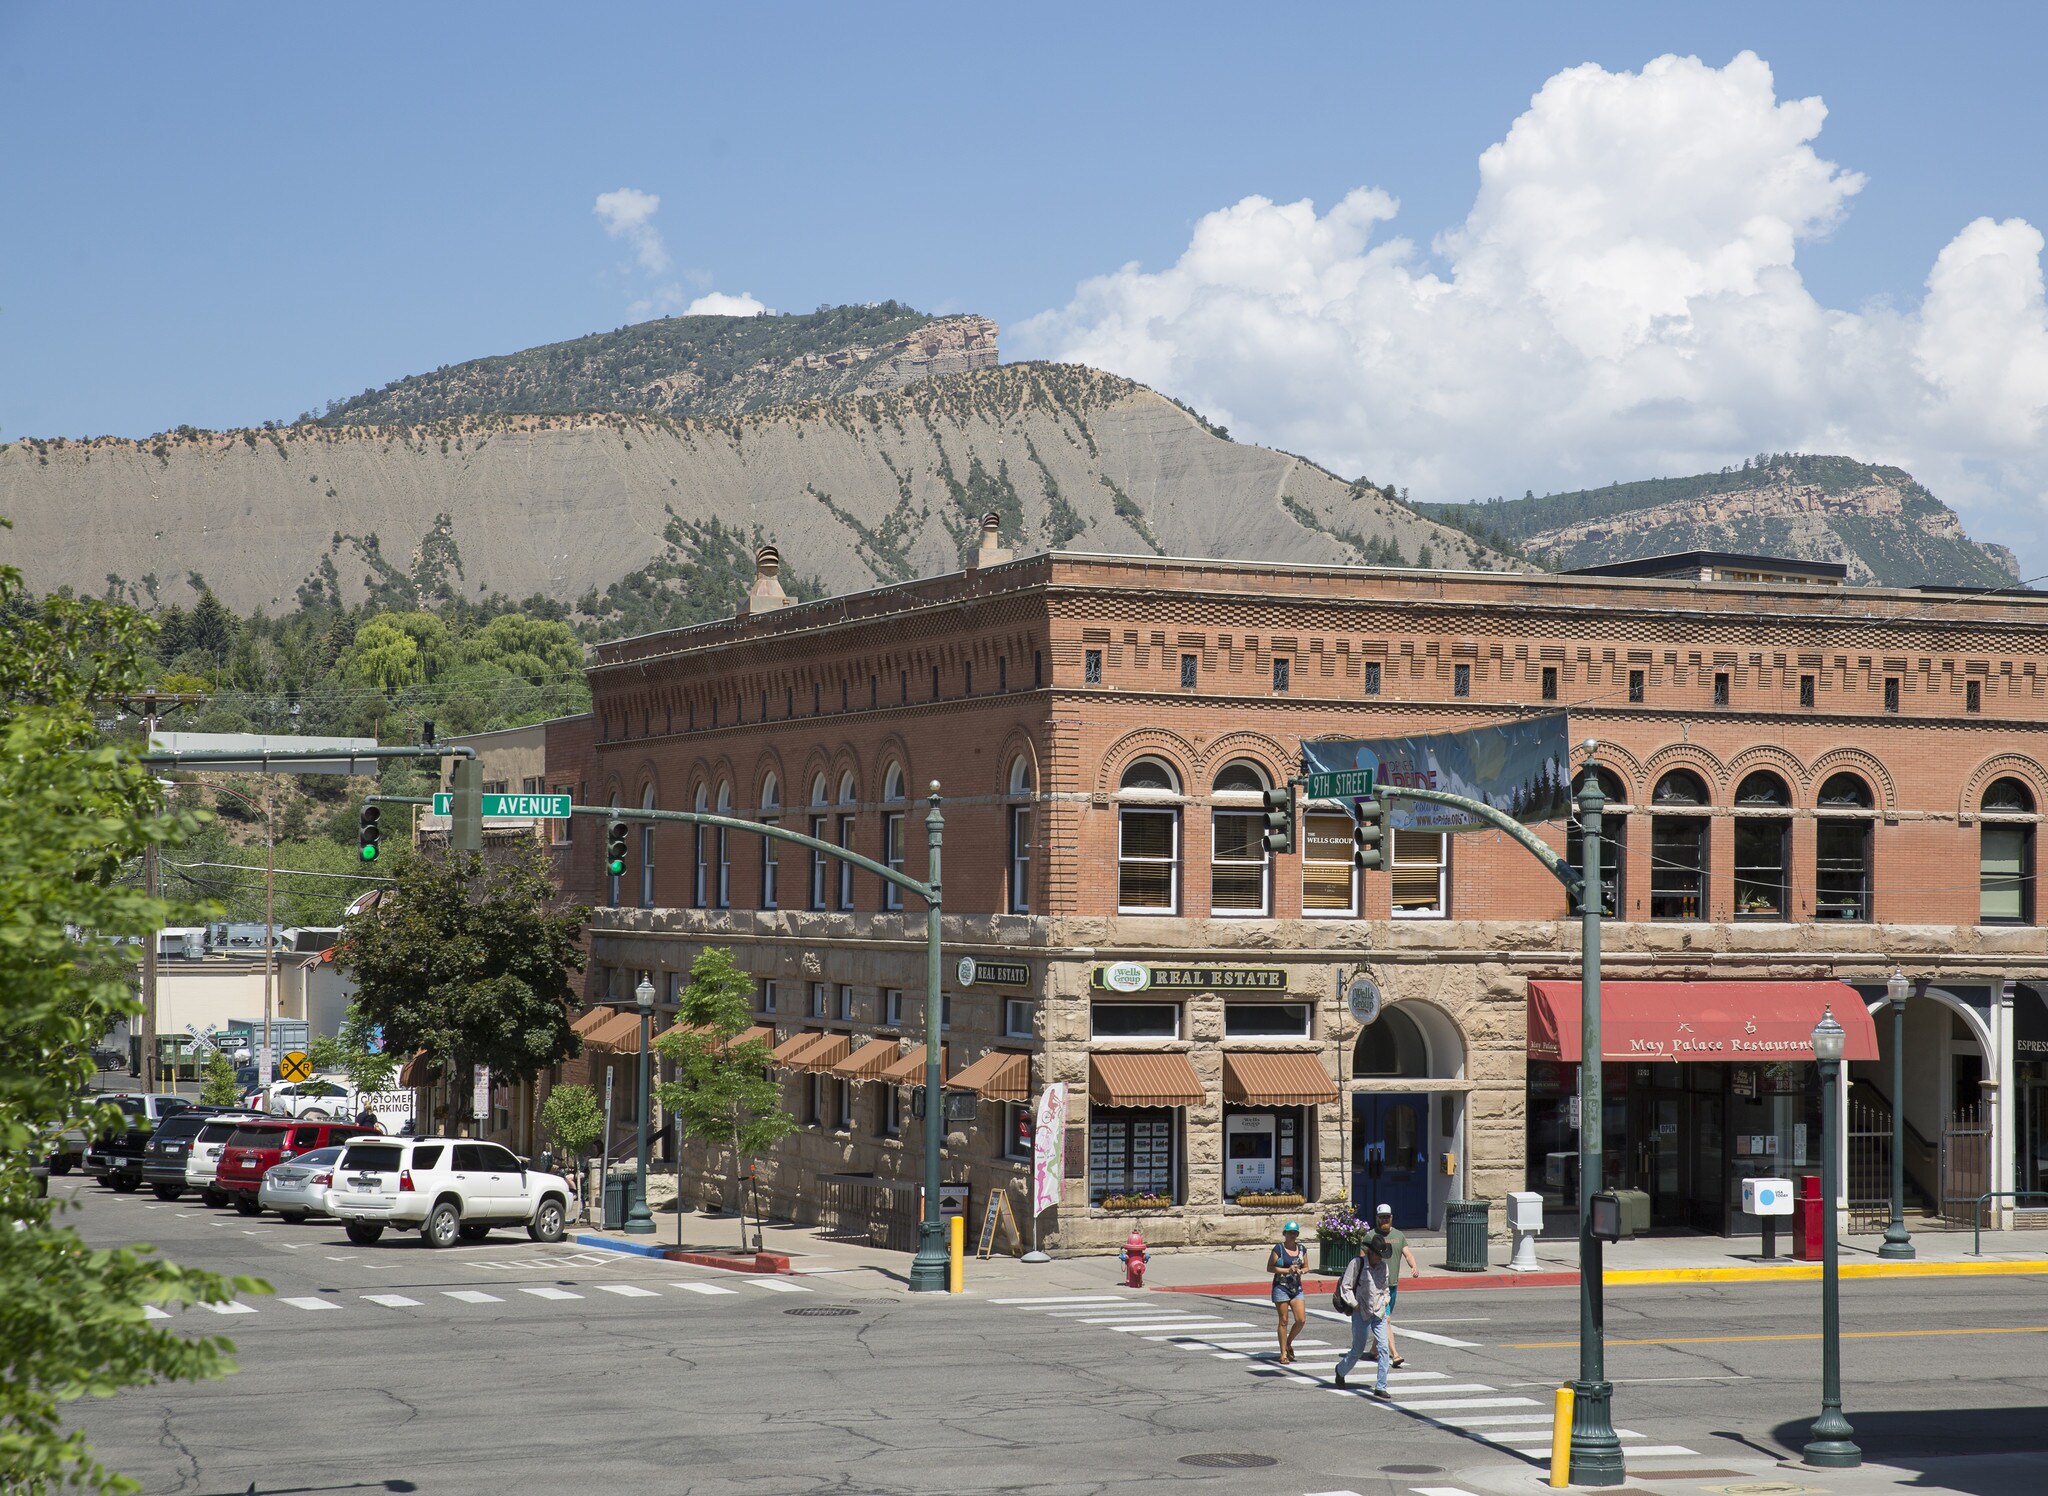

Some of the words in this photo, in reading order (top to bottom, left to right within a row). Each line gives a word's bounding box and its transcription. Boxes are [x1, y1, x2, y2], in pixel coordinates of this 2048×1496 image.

[1313, 775, 1329, 796] 9TH
[1335, 772, 1368, 795] STREET
[497, 797, 562, 814] AVENUE
[977, 966, 995, 980] REAL
[997, 967, 1025, 981] ESTATE
[1117, 967, 1141, 976] Wells
[1155, 970, 1204, 985] REAL
[1211, 971, 1280, 986] ESTATE
[1114, 974, 1141, 984] Group
[1354, 986, 1374, 1000] Wells
[1352, 998, 1374, 1012] Group
[186, 1022, 217, 1053] CROSSING
[1629, 1038, 1664, 1055] May
[1672, 1037, 1723, 1051] Palace
[1730, 1038, 1814, 1052] Restaurant
[282, 1064, 289, 1072] R
[303, 1064, 310, 1072] R
[360, 1094, 412, 1104] CUSTOMER
[371, 1104, 410, 1113] ARKING
[1661, 1125, 1677, 1133] OPEN
